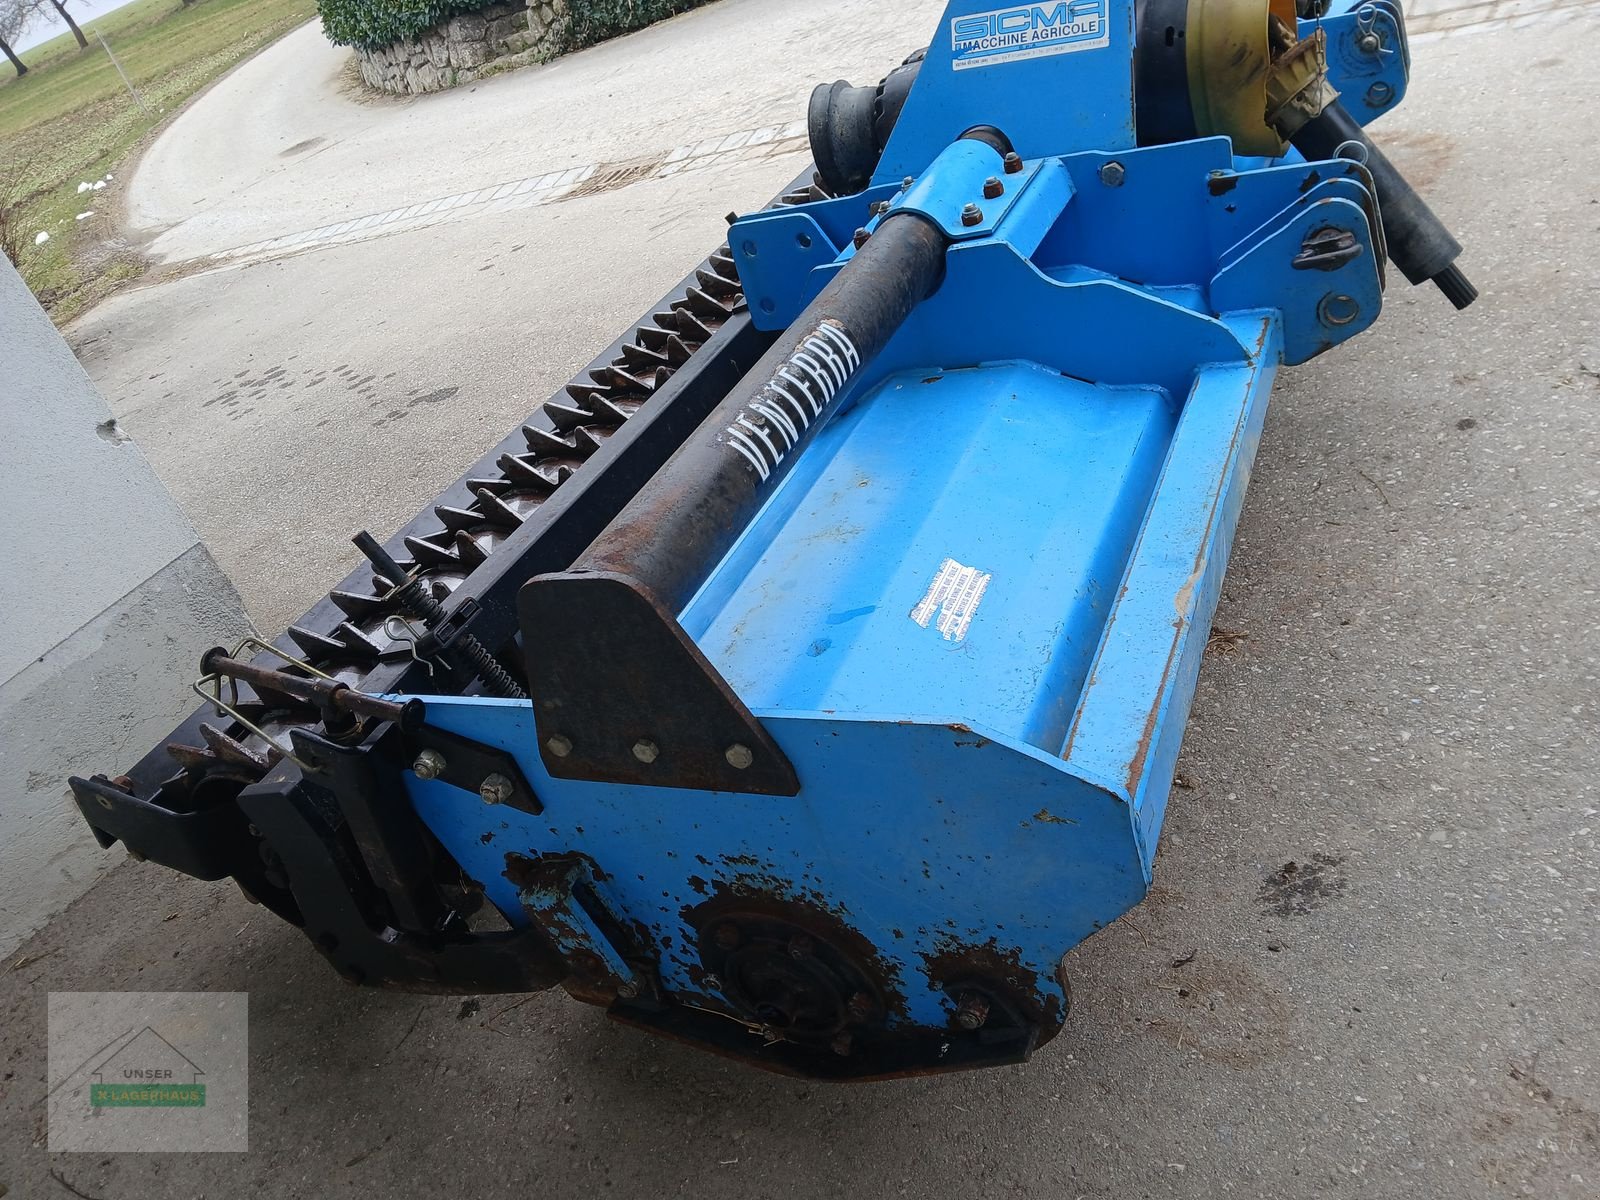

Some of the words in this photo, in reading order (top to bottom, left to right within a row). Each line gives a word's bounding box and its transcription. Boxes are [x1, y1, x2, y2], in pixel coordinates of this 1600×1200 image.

[954, 0, 1106, 42] SICMA
[962, 32, 1027, 52] MACCHINE
[1031, 21, 1097, 41] AGRICOLE
[726, 322, 861, 482] VENTERRA
